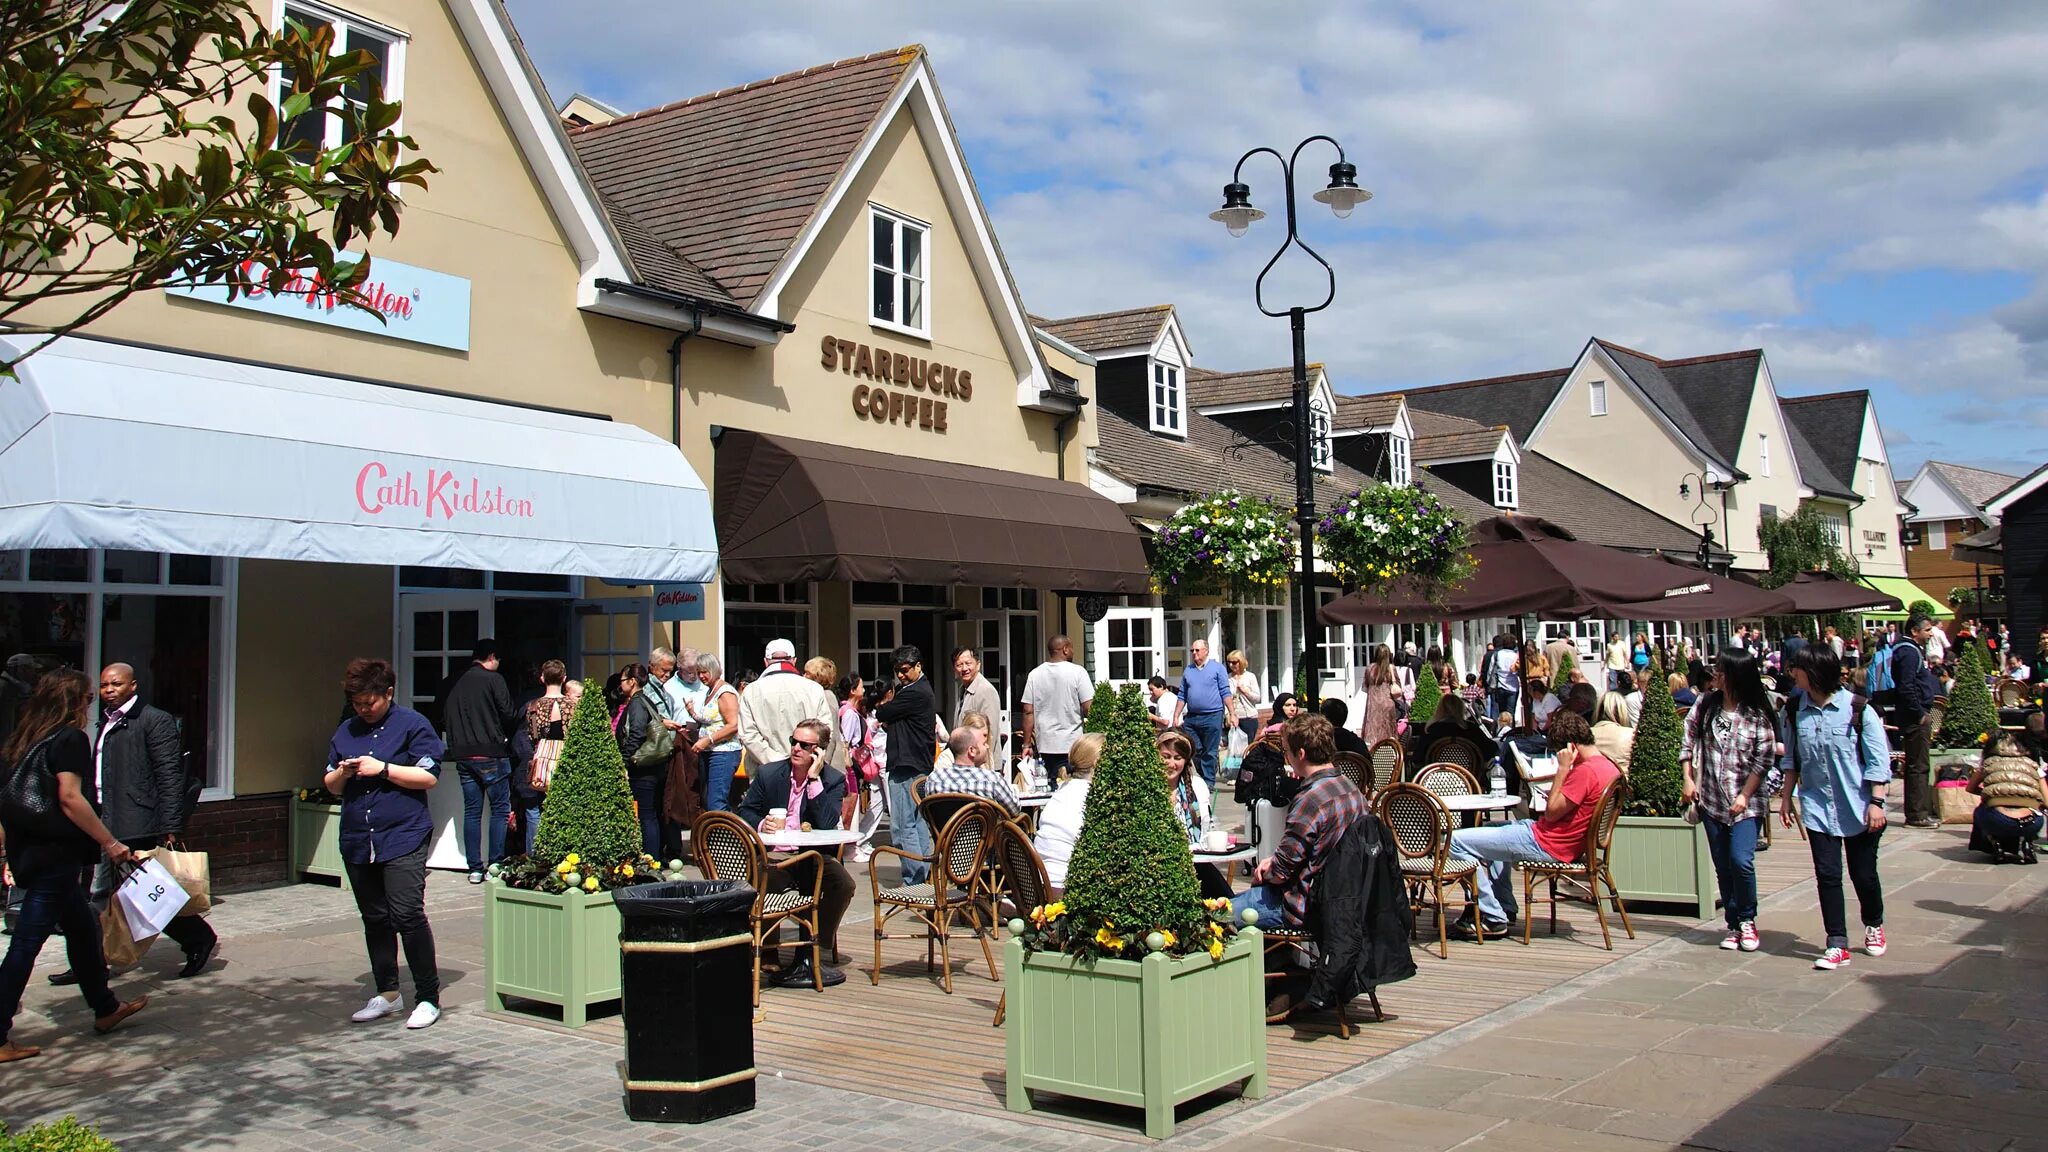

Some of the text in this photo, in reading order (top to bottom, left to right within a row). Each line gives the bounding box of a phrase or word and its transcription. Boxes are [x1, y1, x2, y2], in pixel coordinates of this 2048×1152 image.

[821, 335, 973, 401] STARBUCKS
[852, 384, 948, 433] COFFEE
[355, 461, 535, 521] Cath Kidston
[656, 590, 697, 606] Cath Kidston
